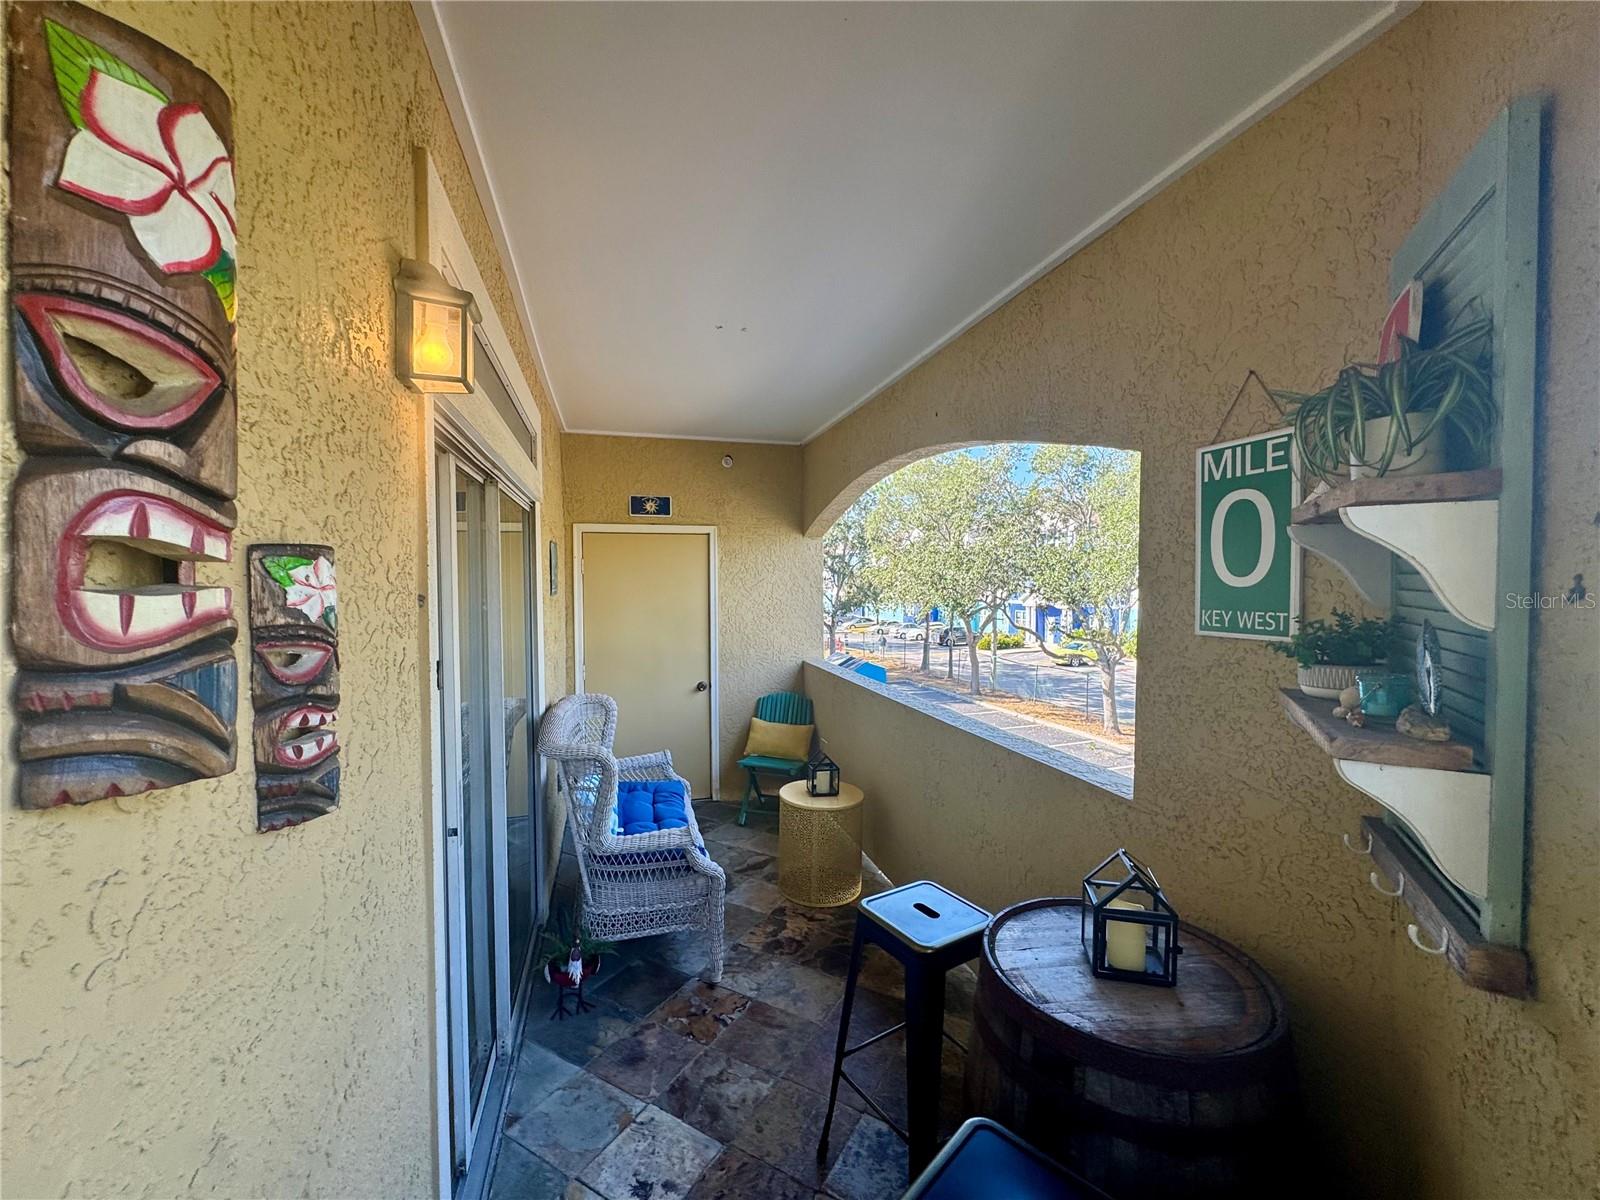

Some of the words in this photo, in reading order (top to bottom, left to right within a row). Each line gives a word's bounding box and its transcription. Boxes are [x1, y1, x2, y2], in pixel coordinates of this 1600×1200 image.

[1203, 436, 1289, 482] MILE
[1211, 488, 1276, 588] 0
[1201, 609, 1233, 627] KEY
[1237, 611, 1288, 631] WEST
